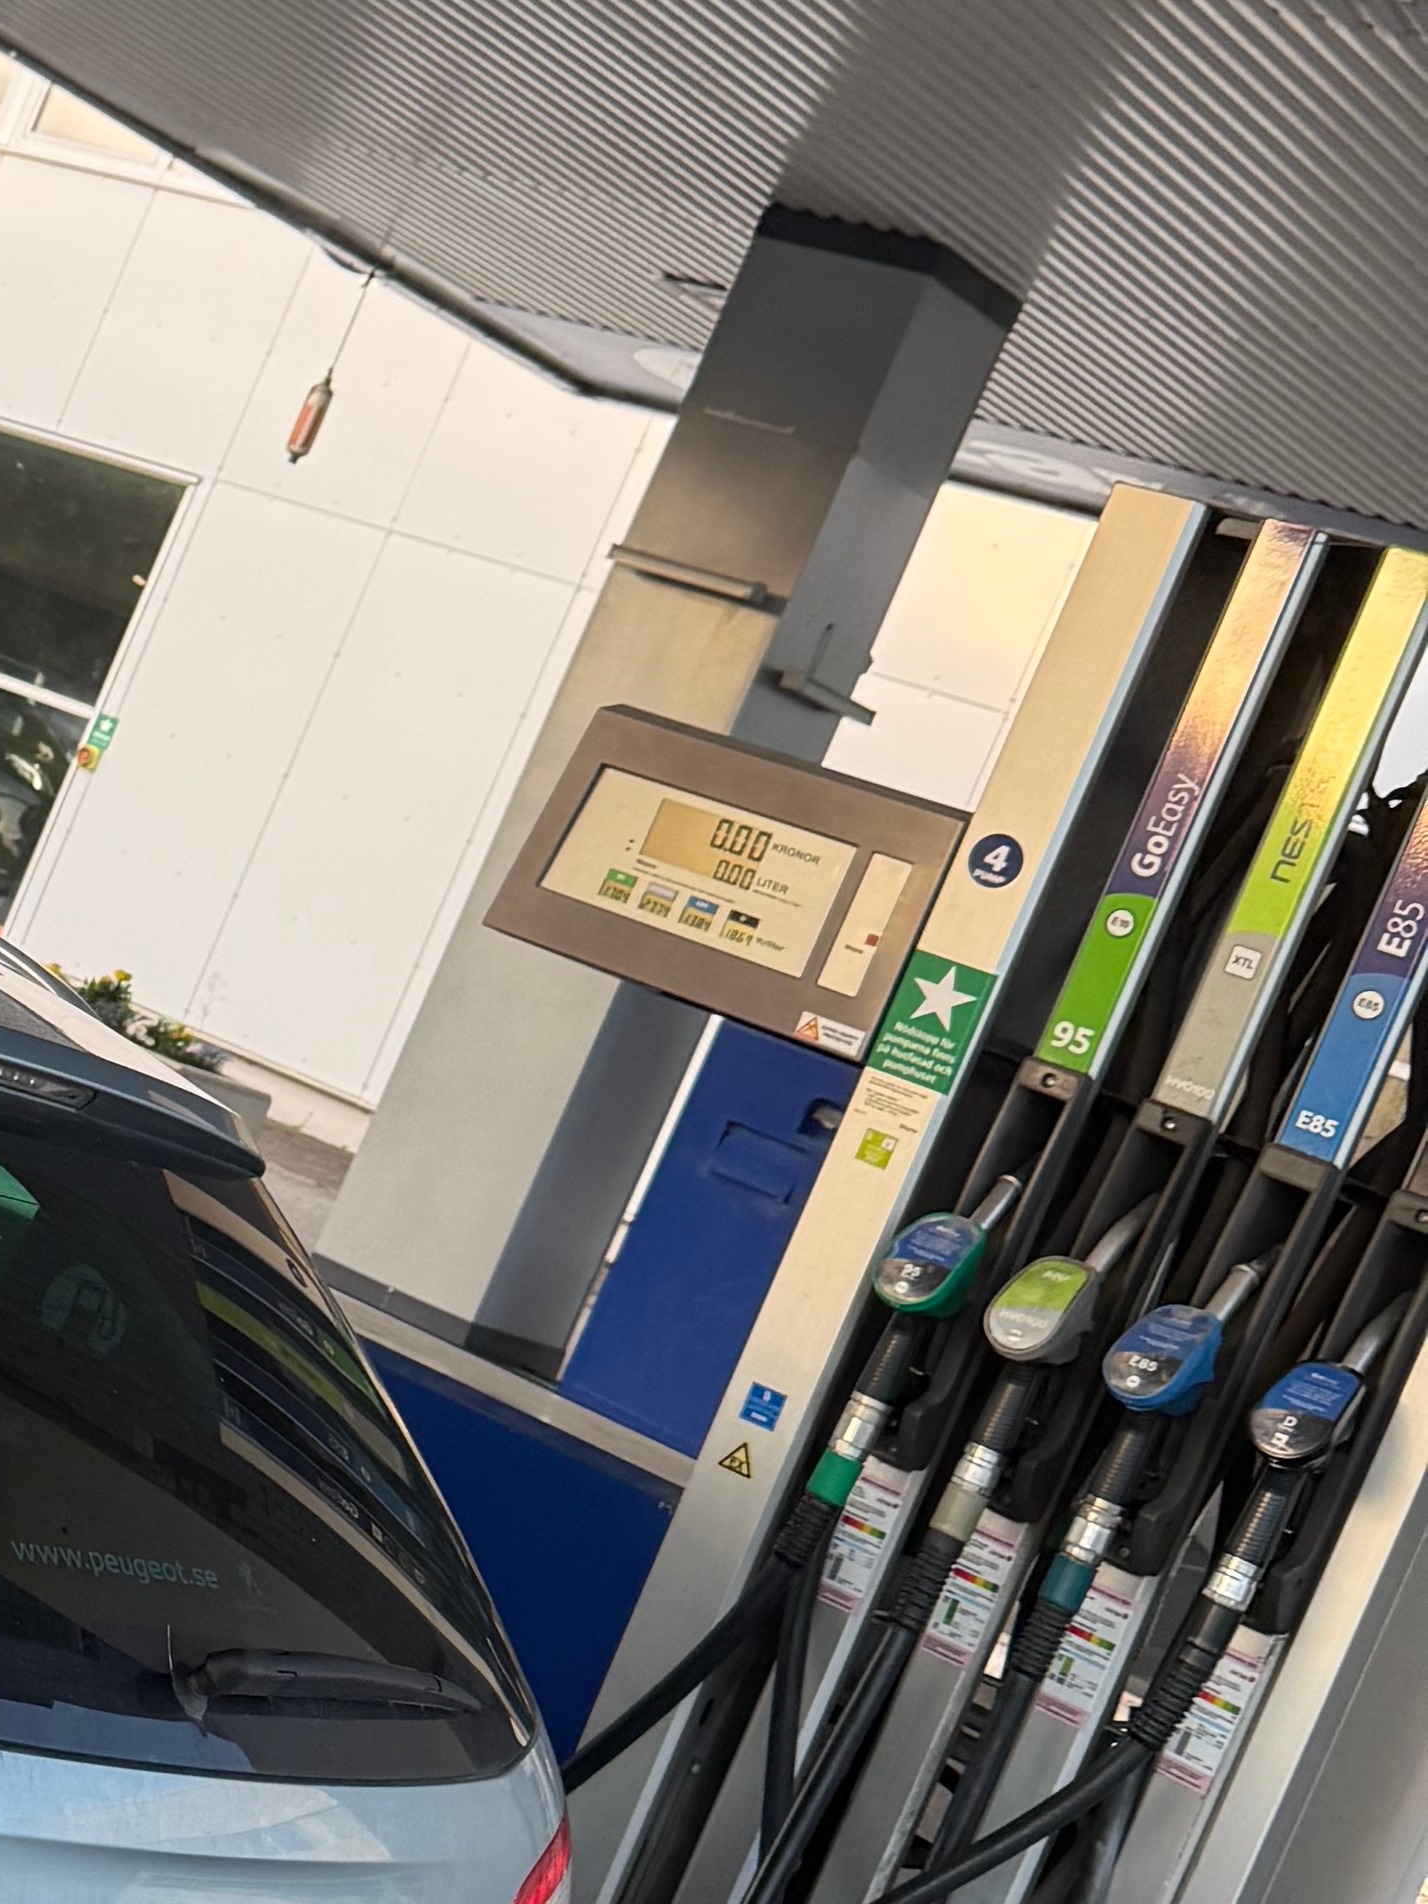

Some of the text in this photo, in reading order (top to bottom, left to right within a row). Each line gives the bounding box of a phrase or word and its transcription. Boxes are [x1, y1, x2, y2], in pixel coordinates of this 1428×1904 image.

[1130, 773, 1201, 878] GoEasy
[710, 818, 821, 866] 0.00 KRONOR
[984, 845, 1012, 872] 4
[756, 876, 789, 896] LITER
[1377, 899, 1426, 959] E85
[1232, 953, 1255, 972] XTL
[1357, 998, 1382, 1012] E85
[1051, 1021, 1095, 1055] 95
[1295, 1109, 1340, 1138] E85
[1128, 1354, 1158, 1373] E85
[10, 1540, 221, 1589] www.peugeot.se
